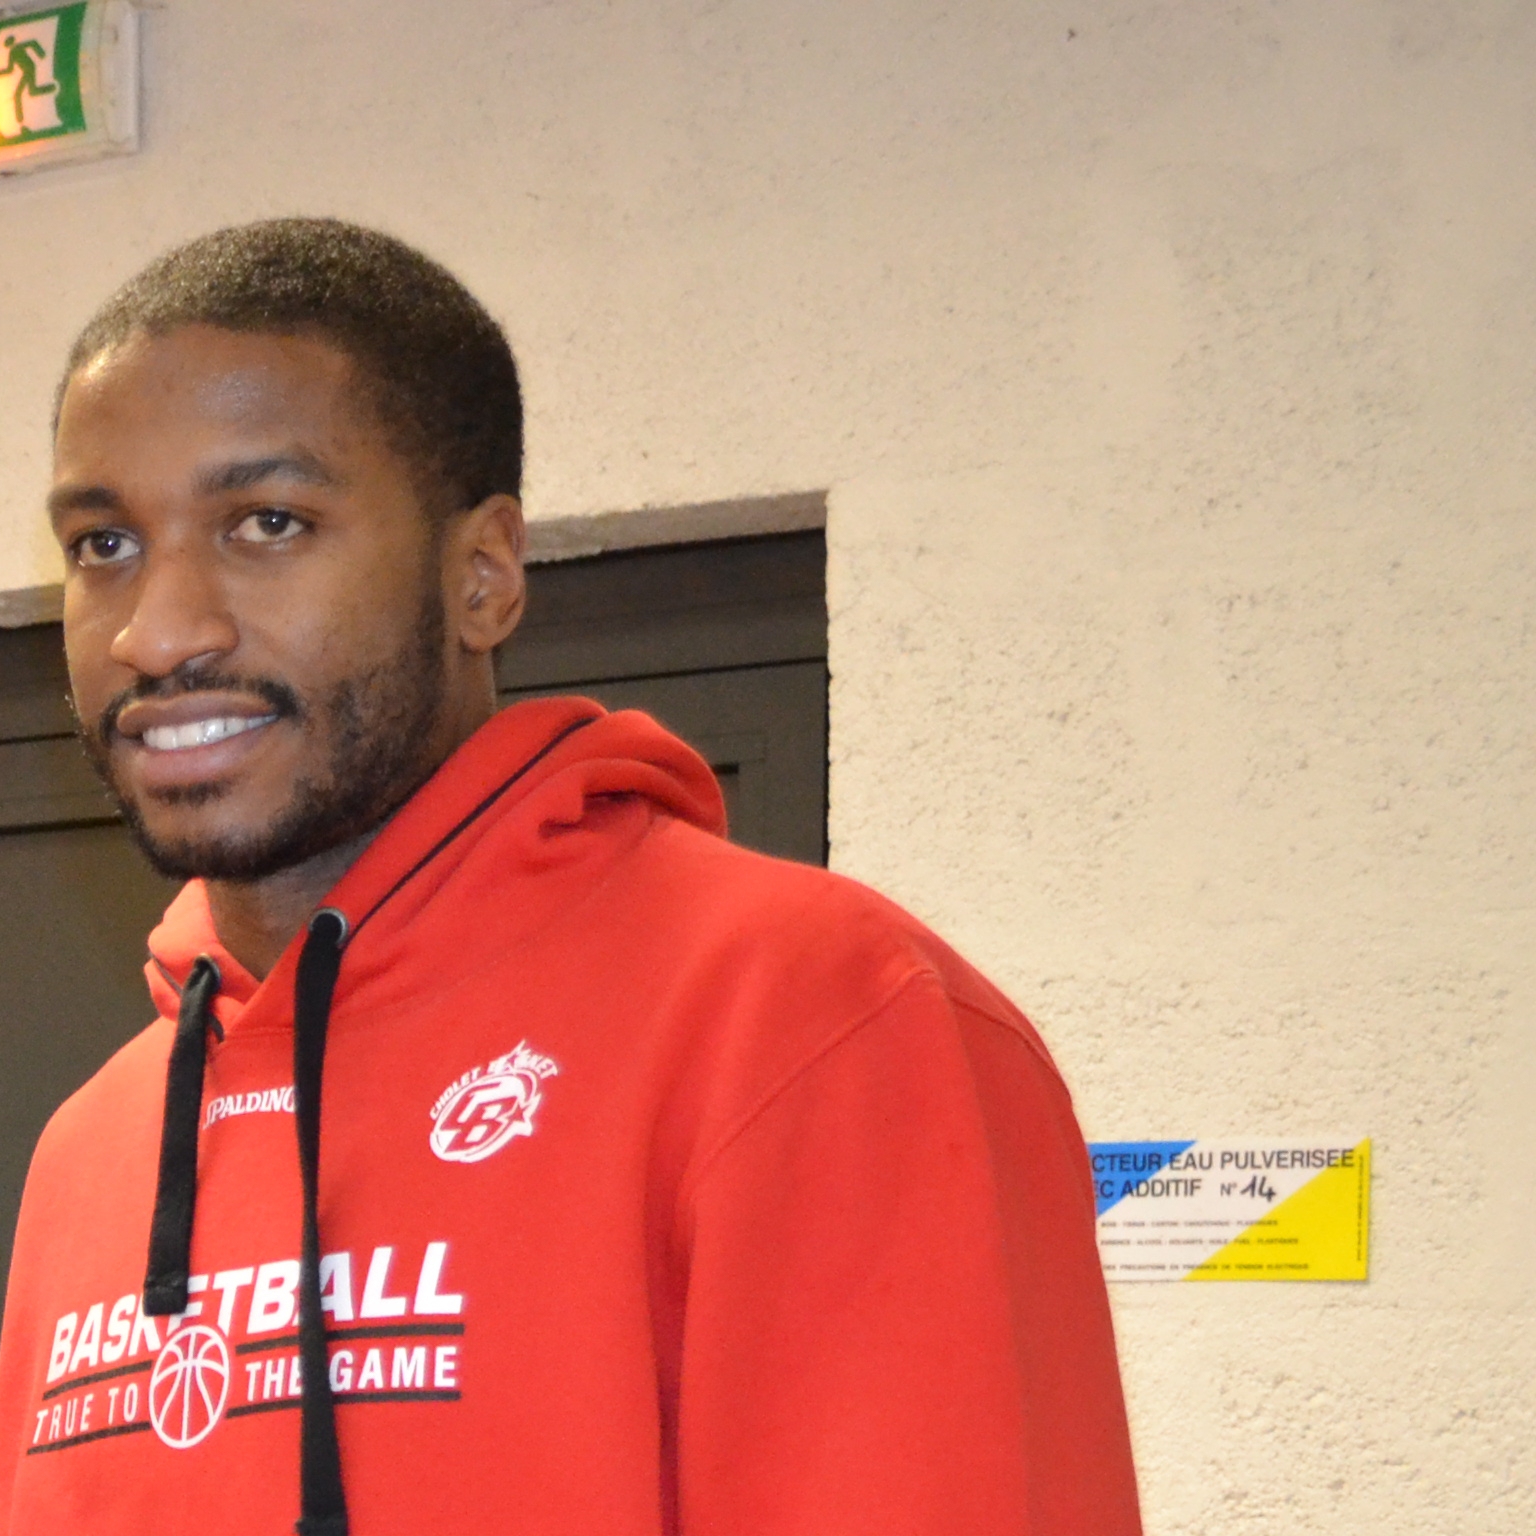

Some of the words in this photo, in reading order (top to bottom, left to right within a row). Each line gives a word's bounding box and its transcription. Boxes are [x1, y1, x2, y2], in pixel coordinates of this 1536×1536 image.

[1169, 1151, 1214, 1171] EAU
[1220, 1148, 1355, 1170] PULVERISEE
[1120, 1178, 1203, 1197] ADDITIF
[1240, 1174, 1277, 1203] 14
[32, 1391, 90, 1445] TRUE
[108, 1384, 139, 1425] TO
[330, 1345, 458, 1392] GAME
